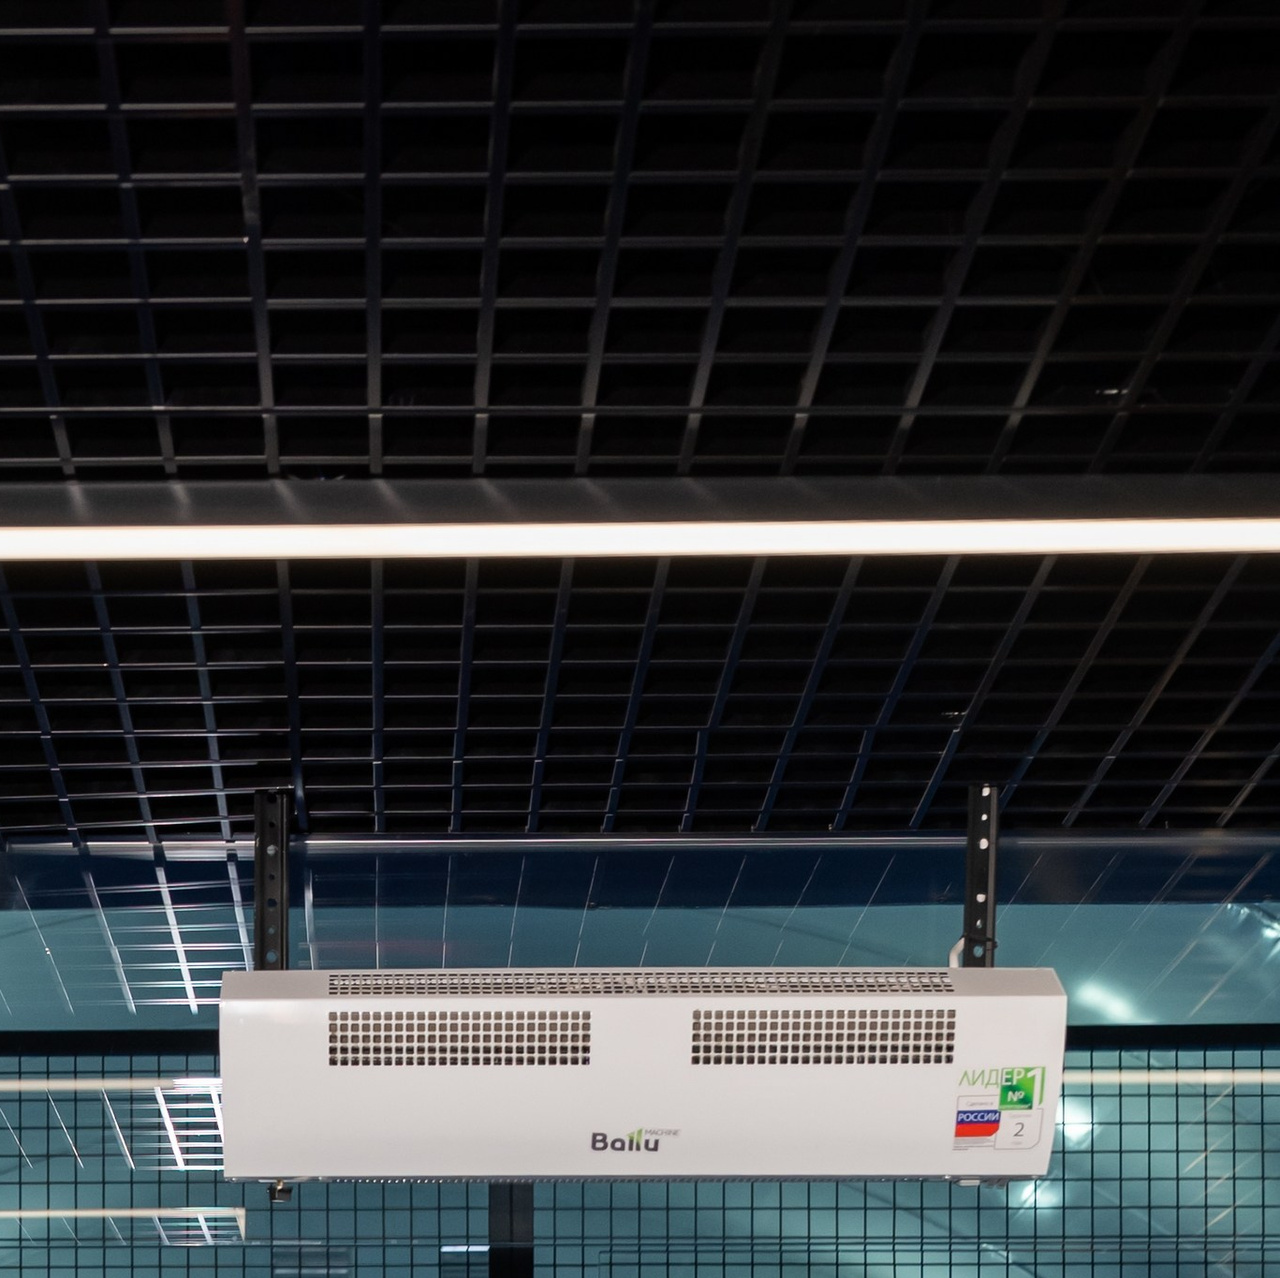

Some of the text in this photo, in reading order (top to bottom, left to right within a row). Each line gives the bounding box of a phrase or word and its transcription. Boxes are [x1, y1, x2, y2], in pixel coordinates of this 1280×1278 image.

[958, 1068, 1025, 1089] ЛИДЕР
[957, 1112, 1000, 1122] РОССИИ
[1013, 1122, 1025, 1137] 2
[591, 1128, 660, 1152] Ballu
